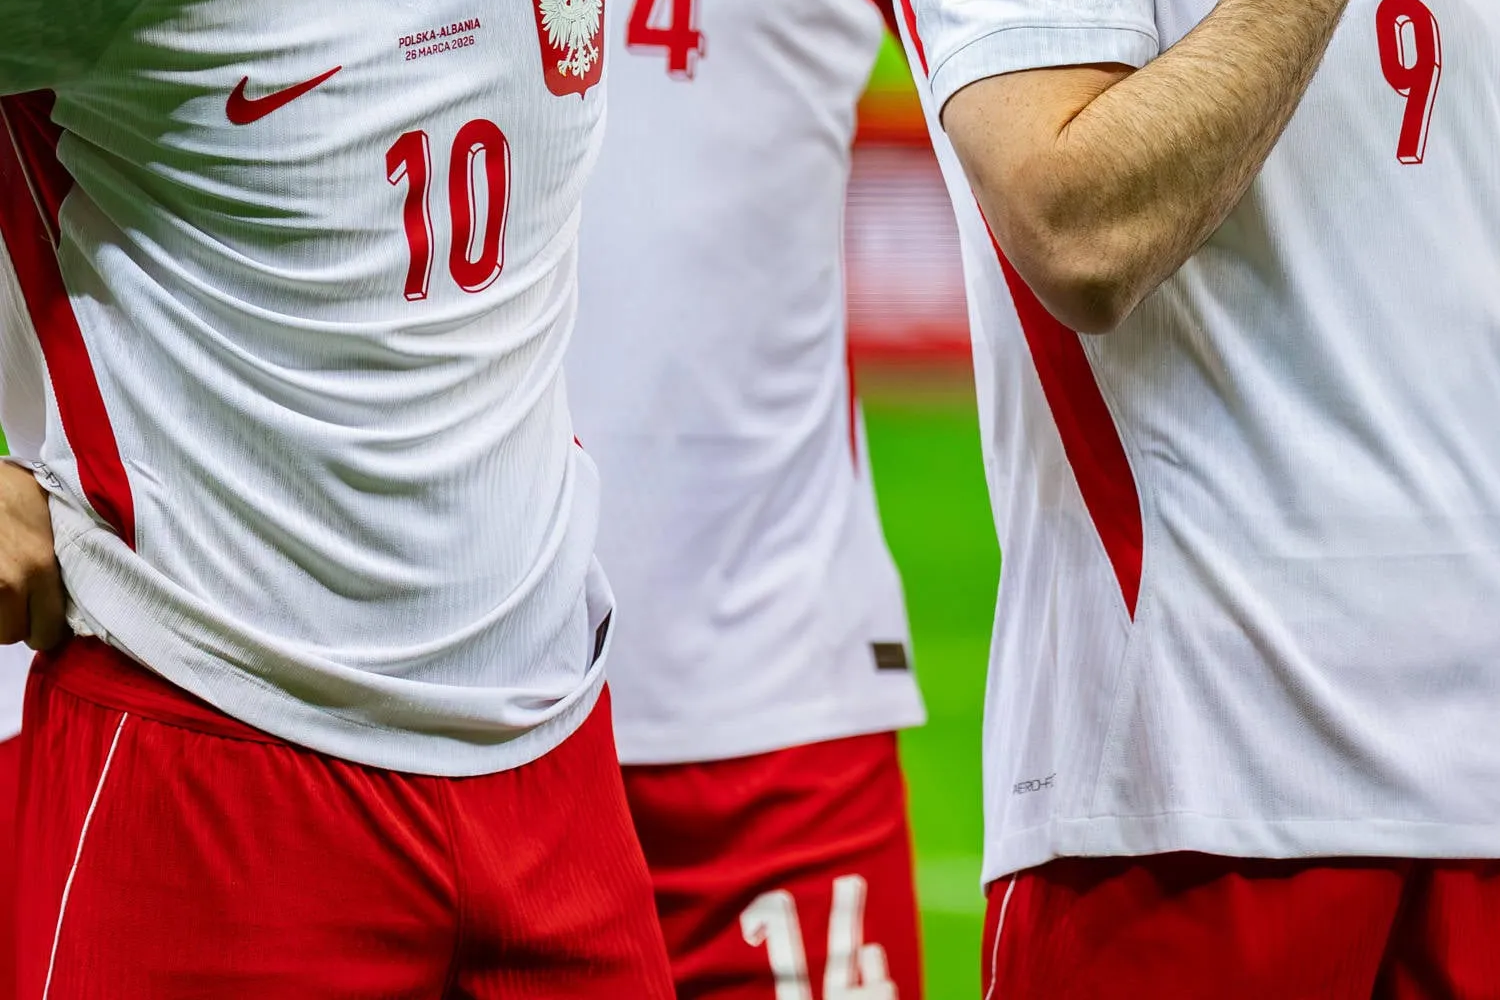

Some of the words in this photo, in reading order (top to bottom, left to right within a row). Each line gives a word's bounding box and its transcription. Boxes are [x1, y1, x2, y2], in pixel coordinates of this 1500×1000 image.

[398, 17, 481, 49] POLSKA-ALBANIA
[405, 49, 417, 61] 26
[418, 41, 451, 58] MARCA
[451, 35, 475, 50] 2026
[385, 118, 511, 302] 10
[738, 873, 900, 1000] 14
